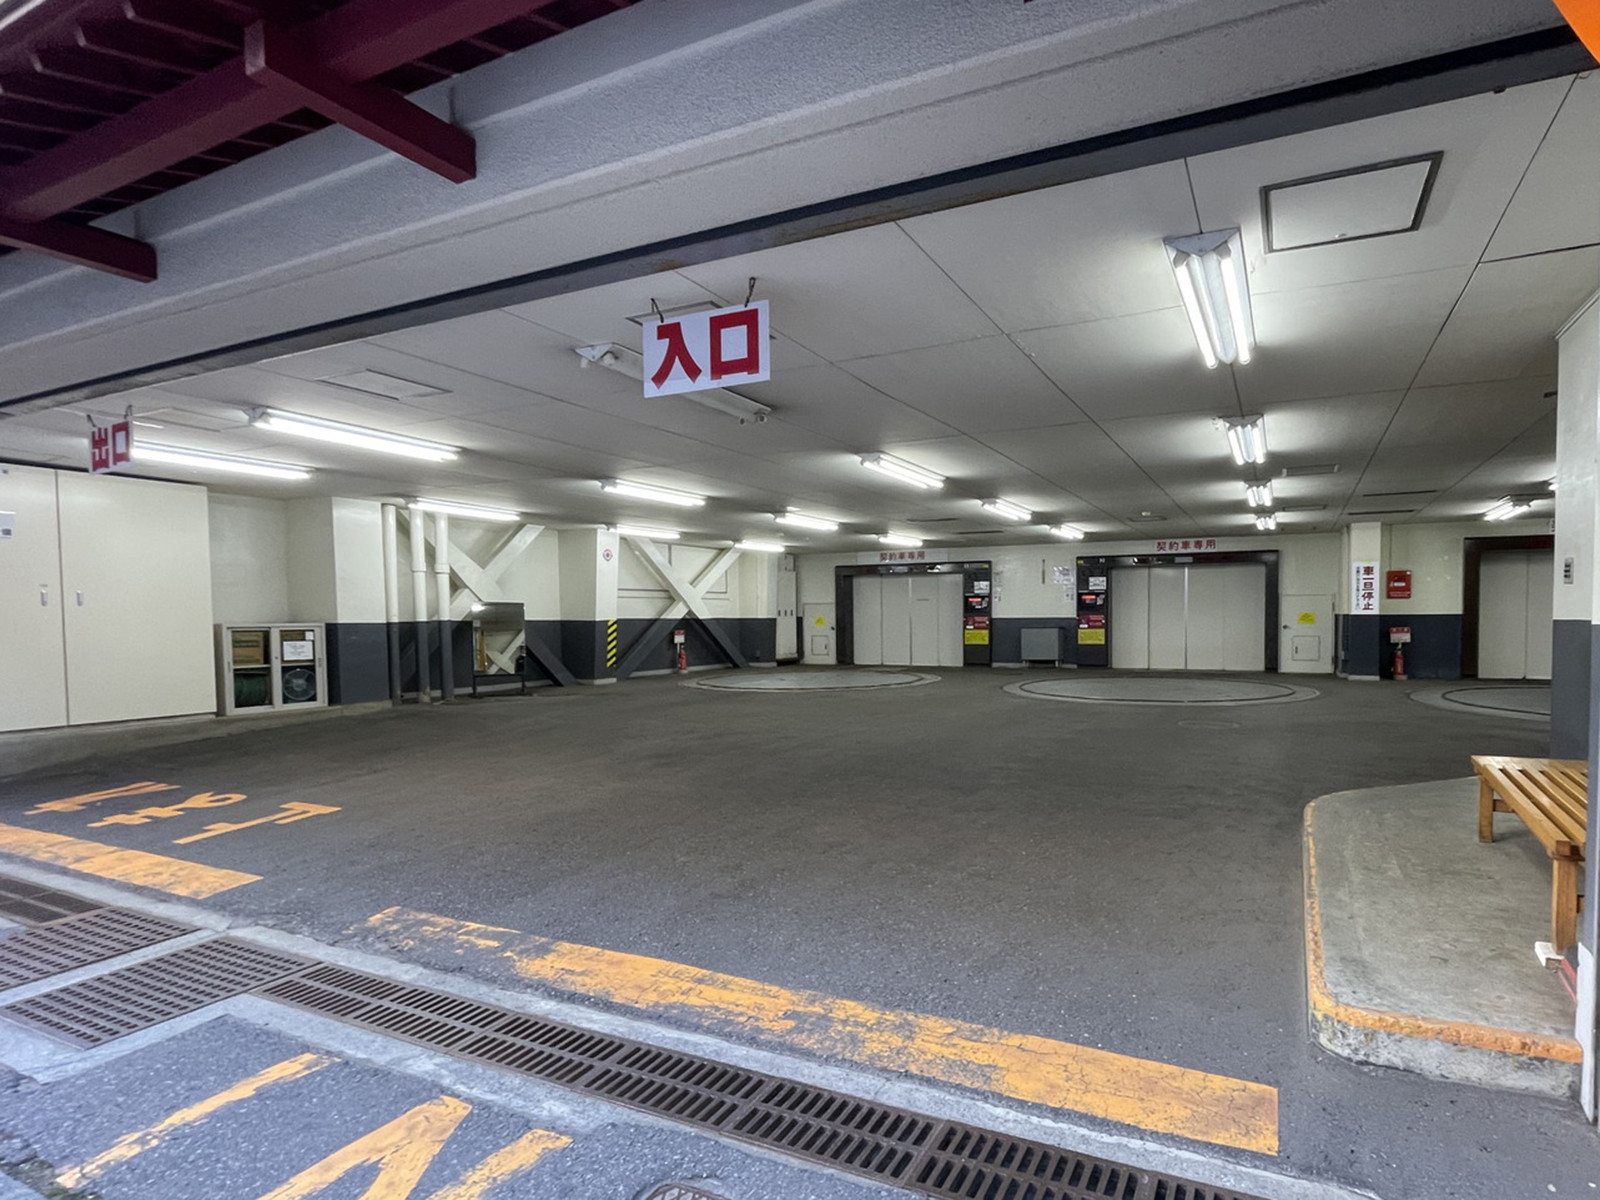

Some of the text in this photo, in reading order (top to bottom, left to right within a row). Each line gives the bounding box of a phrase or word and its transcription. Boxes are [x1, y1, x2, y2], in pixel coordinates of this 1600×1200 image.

[651, 308, 760, 390] 入口
[91, 421, 130, 472] 出口
[1157, 539, 1216, 551] 契約車専用
[1362, 566, 1374, 610] 車一旦停止
